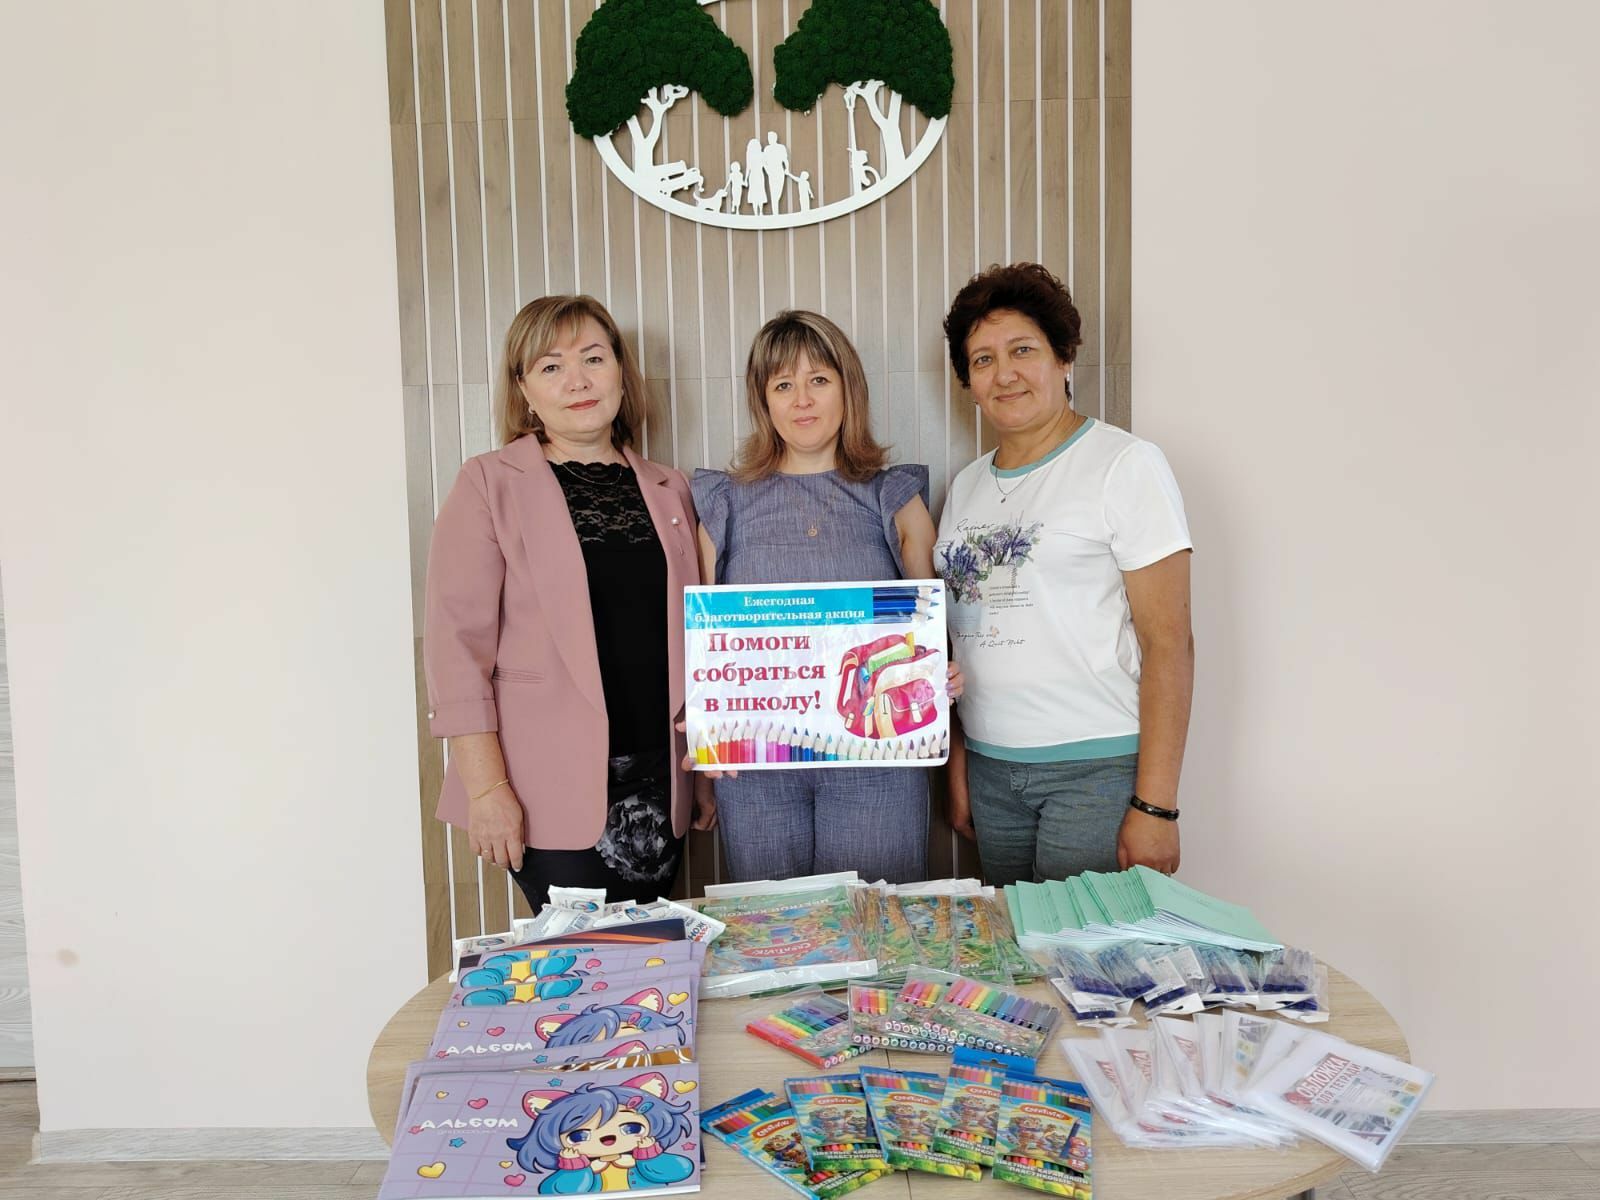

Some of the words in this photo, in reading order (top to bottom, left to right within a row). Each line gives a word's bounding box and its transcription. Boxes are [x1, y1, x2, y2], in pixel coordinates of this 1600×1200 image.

[743, 595, 815, 607] Ежегодная
[694, 610, 822, 623] благотворительная
[825, 609, 865, 620] акция
[708, 633, 811, 652] Помоги
[693, 662, 826, 686] собраться
[704, 698, 720, 712] в
[726, 690, 821, 715] школу!
[1295, 1056, 1350, 1098] ОБЛОЖКА
[1329, 1063, 1362, 1092] ТЕТРАДИ
